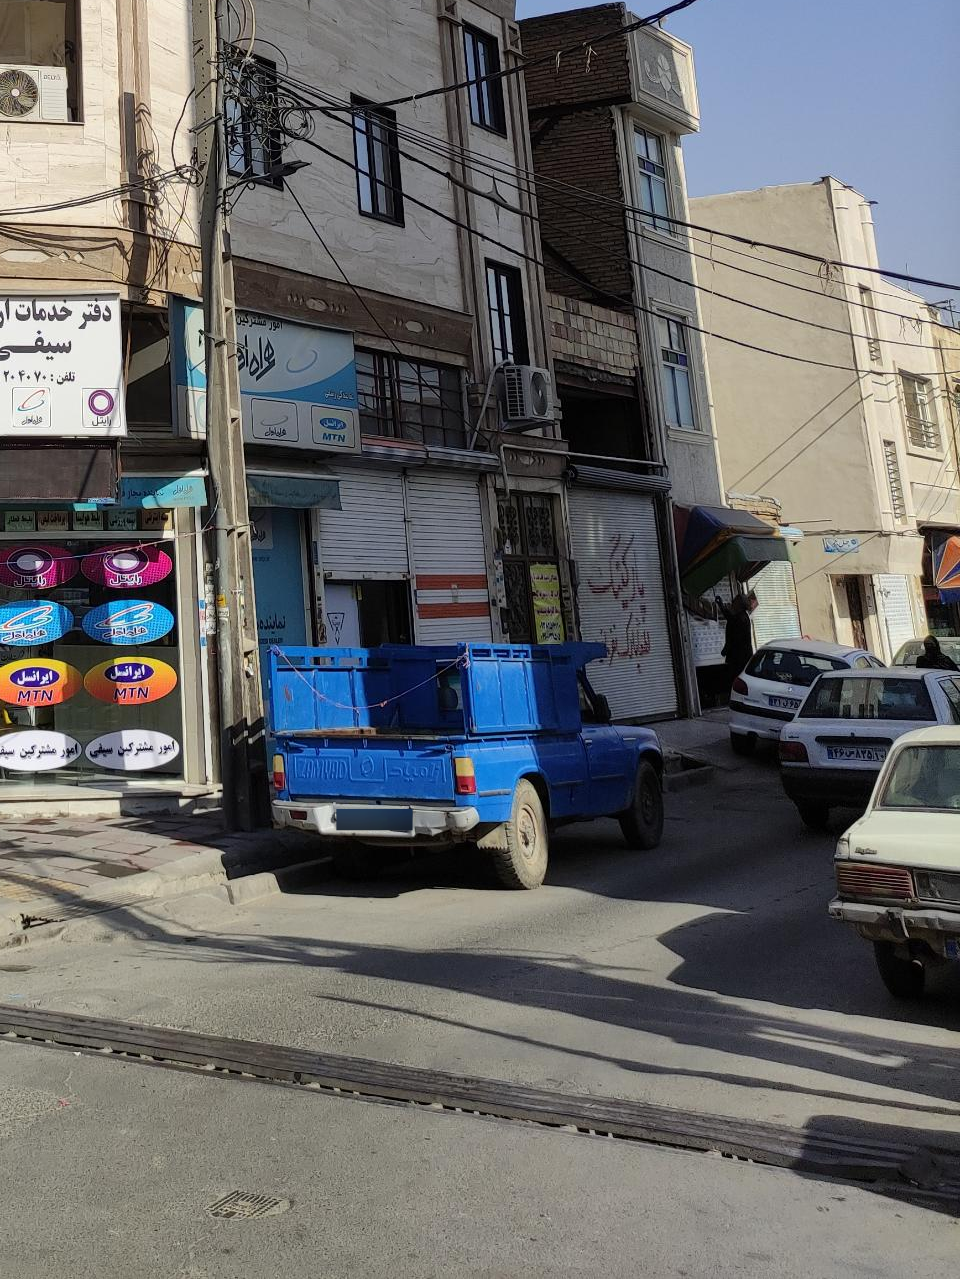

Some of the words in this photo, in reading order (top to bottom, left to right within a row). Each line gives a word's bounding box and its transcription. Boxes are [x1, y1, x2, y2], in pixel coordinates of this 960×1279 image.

[15, 298, 73, 322] خدمات
[78, 299, 112, 329] دفتر
[269, 322, 283, 331] امور
[322, 433, 345, 443] MTN
[13, 574, 47, 587] رایتل
[109, 574, 142, 587] رایتل
[16, 668, 53, 685] ایرانسل
[110, 664, 145, 680] ایرانسل
[17, 690, 53, 702] MTN
[113, 687, 148, 700] MTN
[19, 744, 56, 760] مشترکین
[60, 742, 78, 759] امور
[90, 743, 113, 758] سیفی
[117, 741, 153, 756] مشترکین
[158, 740, 175, 755] امور
